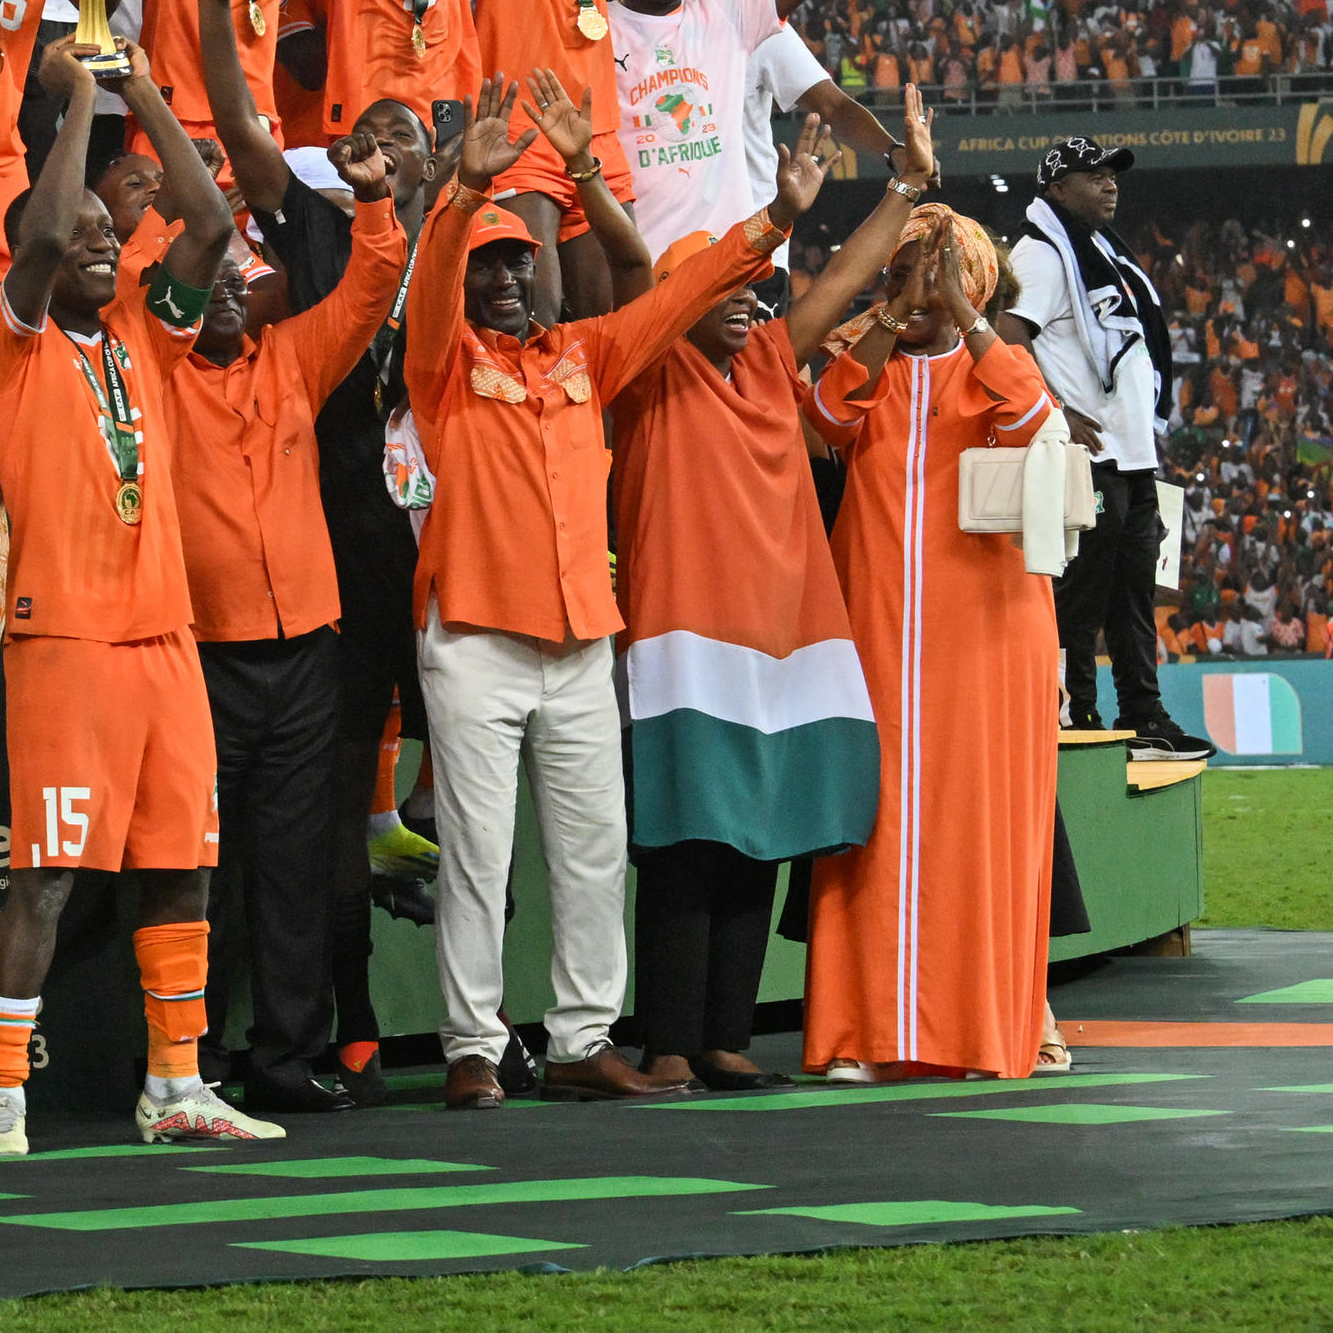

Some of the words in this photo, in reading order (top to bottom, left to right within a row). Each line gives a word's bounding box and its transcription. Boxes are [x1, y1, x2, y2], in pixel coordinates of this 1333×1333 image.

[630, 67, 708, 107] CHAMPIONS
[637, 134, 655, 145] 20
[702, 123, 717, 134] 23
[959, 138, 1015, 152] AFRICA
[1018, 137, 1050, 151] CUP
[1094, 133, 1147, 147] ATIONS
[1150, 129, 1190, 146] CÔTE
[1194, 129, 1263, 144] D'IVOIRE
[1269, 128, 1287, 141] 23
[638, 135, 722, 168] D'AFRIQUE
[407, 257, 416, 269] CUP
[402, 268, 413, 287] AFRICA
[106, 355, 114, 367] CUP
[108, 366, 119, 388] AFRICA
[43, 786, 91, 857] 15
